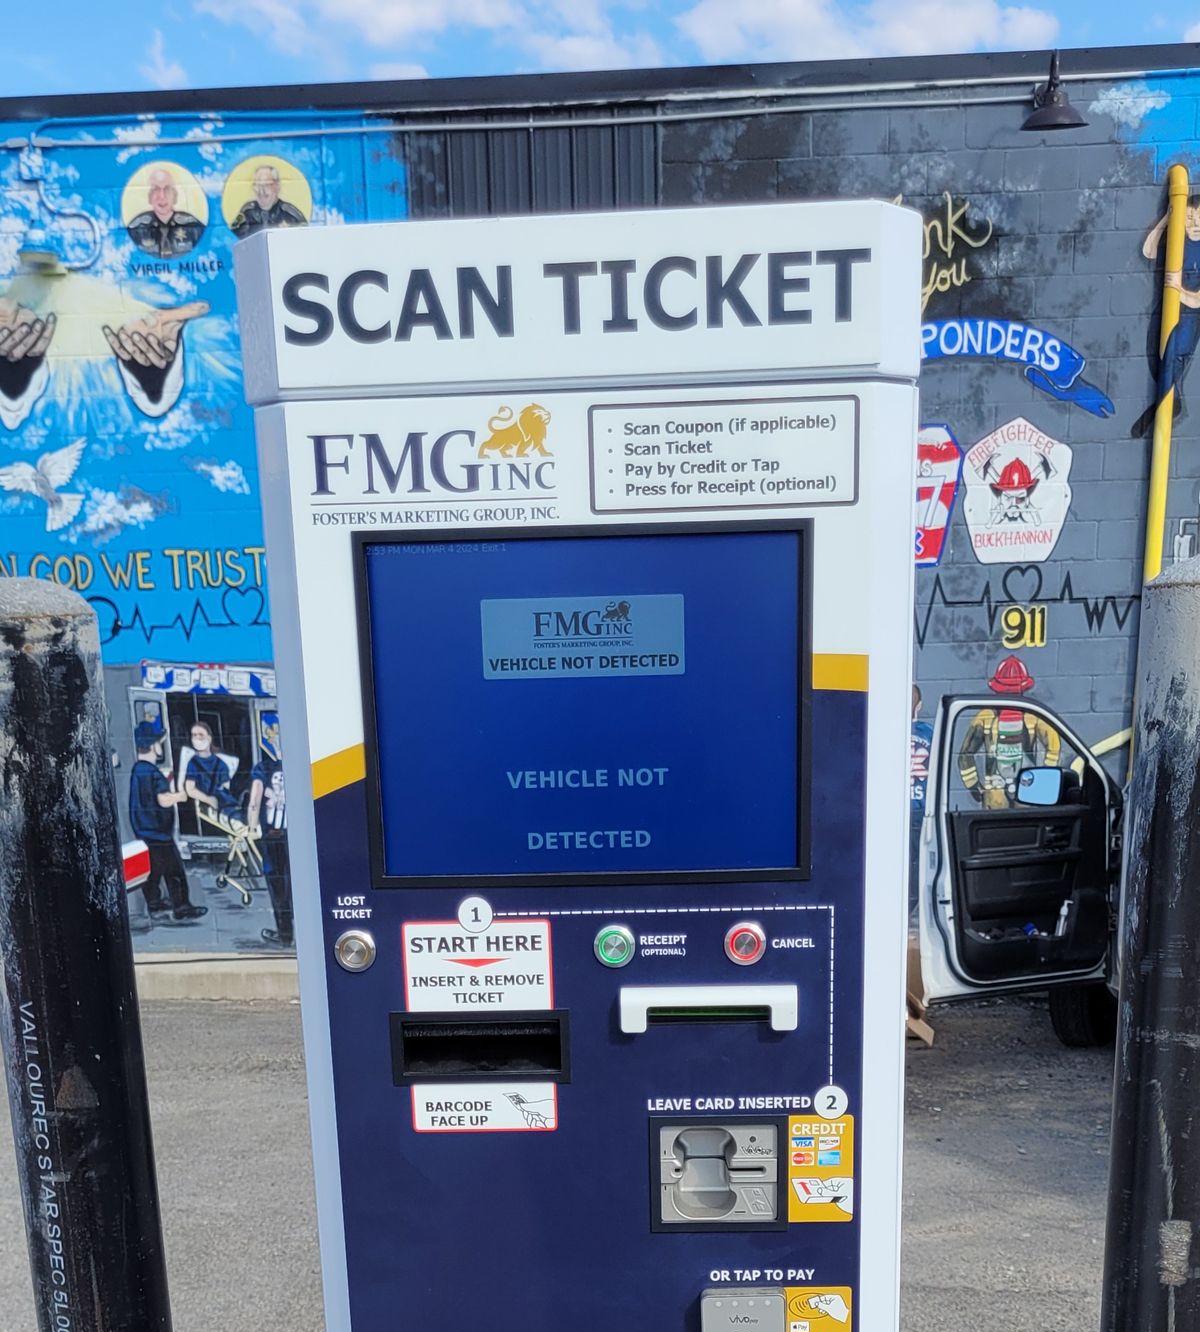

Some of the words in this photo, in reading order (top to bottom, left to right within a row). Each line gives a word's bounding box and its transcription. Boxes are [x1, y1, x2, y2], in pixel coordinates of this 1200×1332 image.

[130, 263, 173, 276] VIRGIL
[178, 260, 225, 272] MILLER
[281, 265, 515, 347] SCAN
[543, 248, 872, 335] TICKET
[623, 421, 661, 436] Scan
[665, 419, 724, 437] Coupon
[728, 417, 747, 436] (if
[750, 414, 837, 433] applicable)
[624, 442, 661, 456] Scan
[665, 440, 713, 454] Ticket
[968, 424, 1055, 468] FIREFIGHTER
[307, 430, 484, 496] FMG
[490, 461, 556, 491] INC
[625, 463, 652, 479] Pay
[657, 461, 676, 477] by
[680, 460, 727, 475] Credit
[731, 461, 747, 473] or
[751, 458, 780, 475] Tap
[626, 483, 667, 496] Press
[671, 481, 693, 495] for
[698, 479, 756, 496] Receipt
[759, 475, 837, 495] (optional)
[312, 511, 377, 526] FOSTER'S
[380, 509, 470, 524] MARKETING
[473, 507, 528, 523] GROUP,
[530, 506, 560, 520] INC.
[974, 529, 1053, 549] BUCKHANNON
[30, 553, 94, 589] GOD
[101, 550, 155, 590] WE
[164, 547, 266, 589] TRUST
[532, 610, 605, 637] FMG
[606, 622, 633, 635] INC
[1002, 605, 1047, 647] 911
[488, 657, 556, 671] VEHICLE
[561, 656, 595, 670] NOT
[599, 654, 679, 668] DETECTED
[506, 769, 609, 789] VEHICLE
[618, 768, 669, 787] NOT
[527, 830, 652, 850] DETECTED
[337, 896, 366, 906] LOST
[332, 909, 372, 919] TICKET
[470, 907, 482, 923] 1
[410, 936, 479, 954] START
[486, 935, 543, 952] HERE
[640, 935, 688, 945] RECEIPT
[771, 938, 816, 949] CANCEL
[641, 948, 687, 957] (OPTIONAL)
[411, 975, 466, 987] INSERT
[470, 975, 480, 987] &
[484, 974, 545, 986] REMOVE
[452, 992, 504, 1003] TICKET
[19, 1001, 51, 1149] VALLOUREC
[425, 1101, 493, 1112] BARCODE
[647, 1099, 692, 1111] LEAVE
[695, 1098, 735, 1110] CARD
[738, 1096, 812, 1109] INSERTED
[826, 1095, 838, 1110] 2
[430, 1116, 466, 1127] FACE
[470, 1115, 488, 1126] UP
[792, 1123, 846, 1135] CREDIT
[795, 1139, 812, 1147] VISA
[38, 1155, 60, 1219] STAR
[48, 1223, 66, 1286] SPEC
[710, 1270, 731, 1281] OR
[733, 1269, 761, 1281] TAP
[764, 1269, 783, 1280] TO
[787, 1269, 815, 1280] PAY
